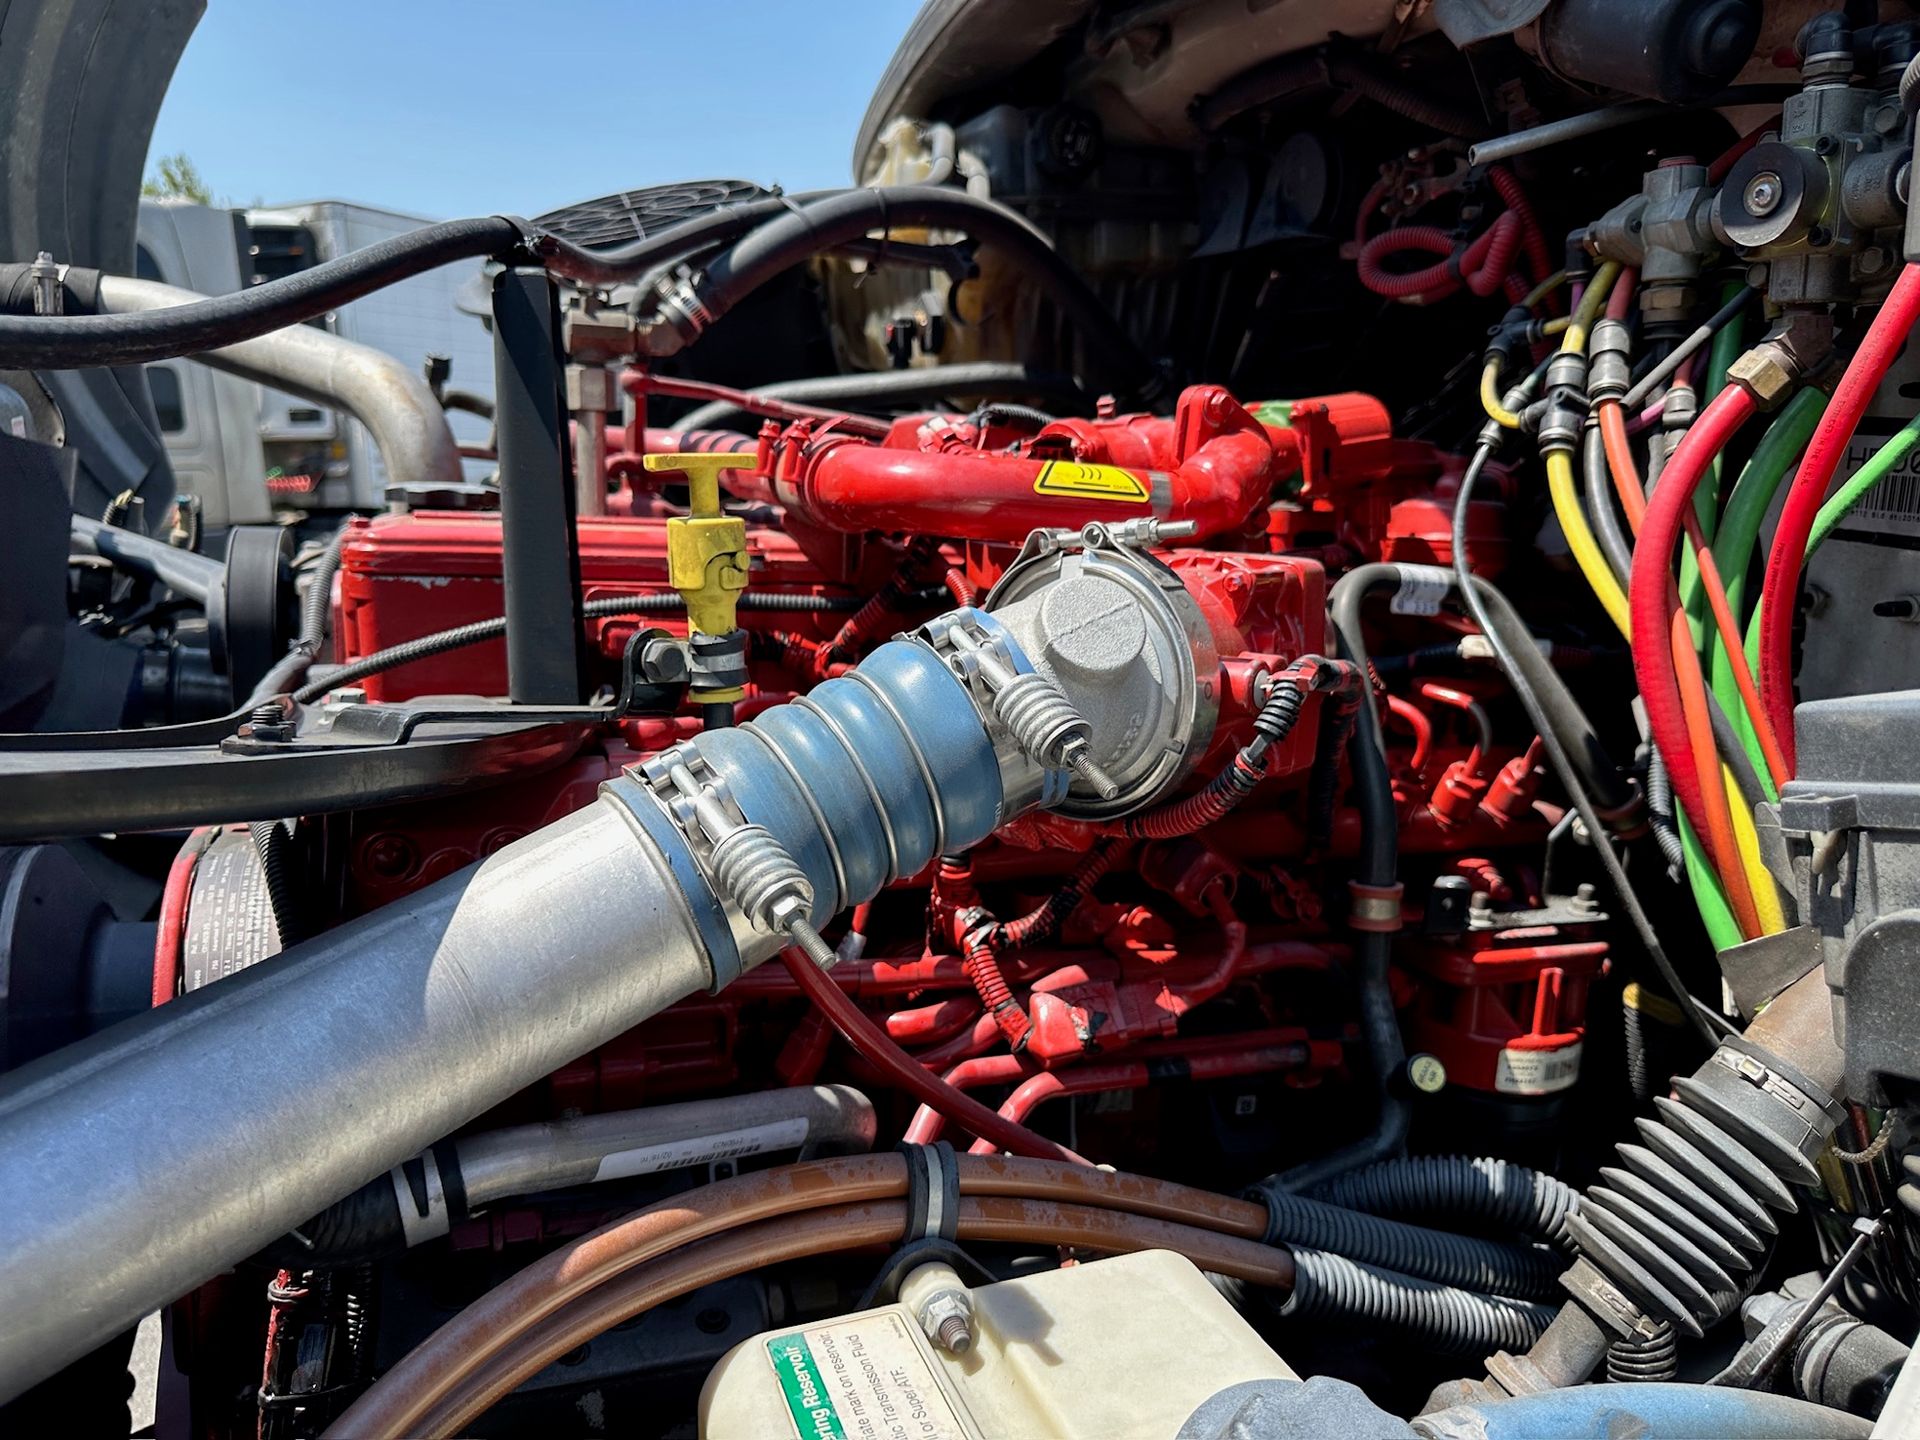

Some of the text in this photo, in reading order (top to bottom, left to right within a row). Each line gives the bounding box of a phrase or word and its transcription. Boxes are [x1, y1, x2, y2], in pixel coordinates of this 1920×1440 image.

[819, 1330, 847, 1374] reservoir.
[845, 1333, 867, 1359] Fluid
[784, 1345, 822, 1408] Reservoir
[839, 1372, 855, 1389] on
[889, 1365, 913, 1387] ATF.
[842, 1389, 866, 1416] mark
[860, 1358, 899, 1425] Transmission
[903, 1389, 927, 1420] Super
[919, 1421, 934, 1432] or
